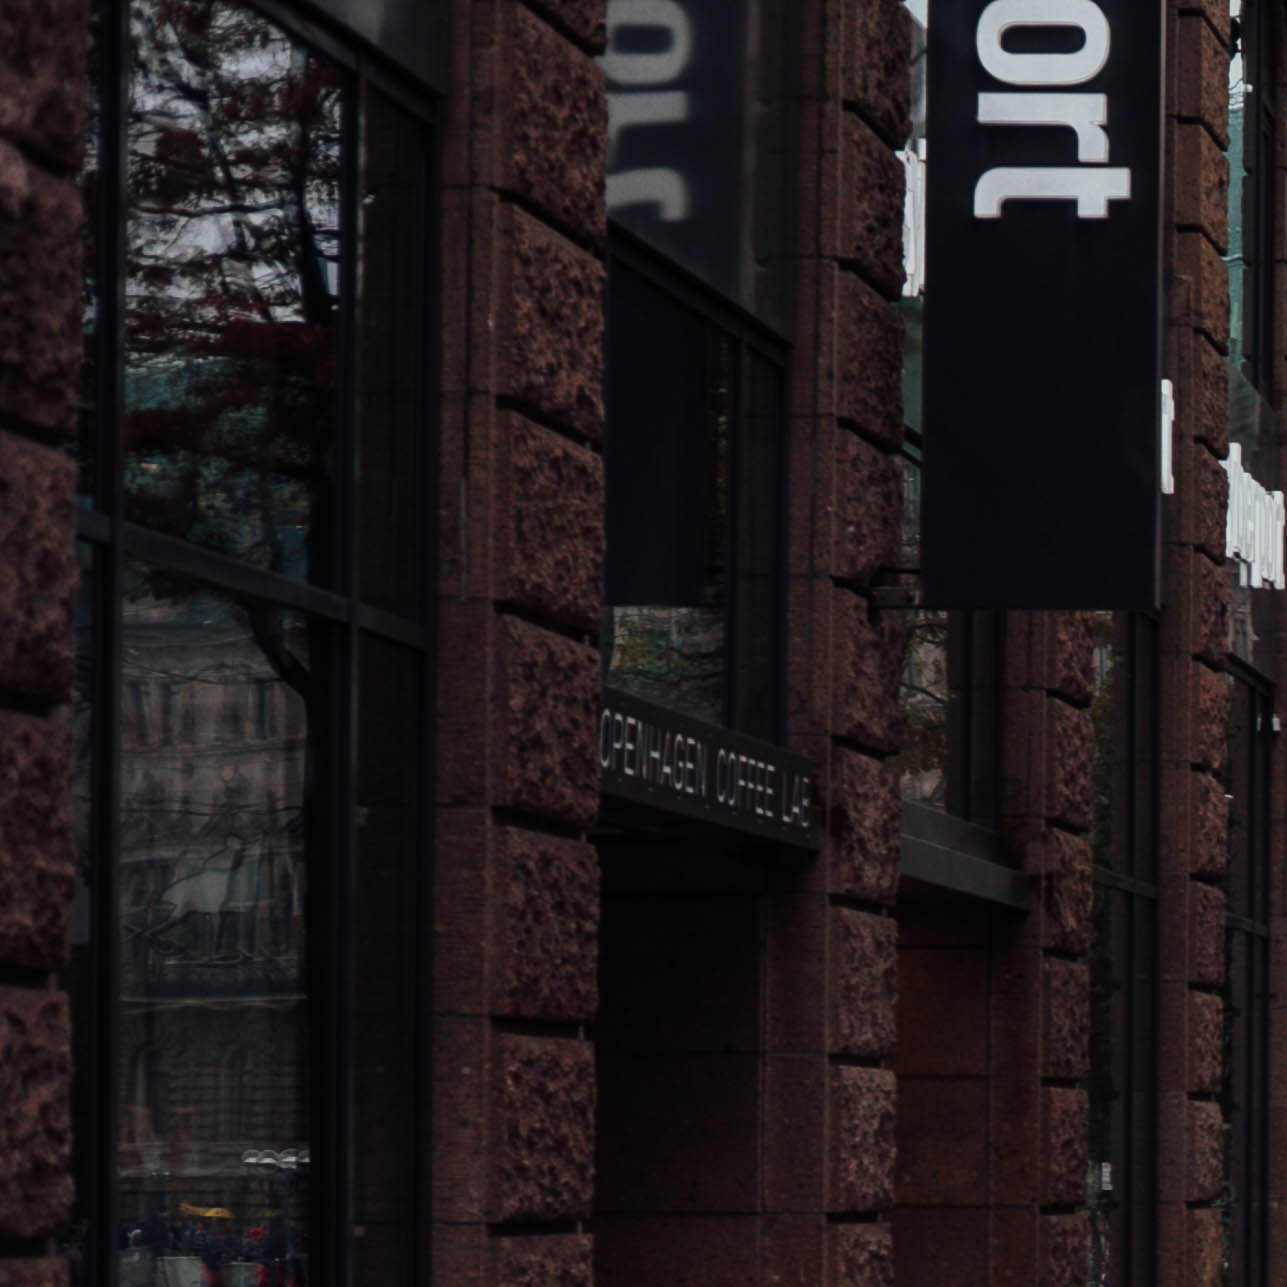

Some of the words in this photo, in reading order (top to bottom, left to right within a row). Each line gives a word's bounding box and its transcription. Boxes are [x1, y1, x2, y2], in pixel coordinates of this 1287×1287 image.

[600, 708, 707, 798] OPENHAGEN
[716, 747, 777, 818] COFFEE
[782, 769, 810, 828] LAB
